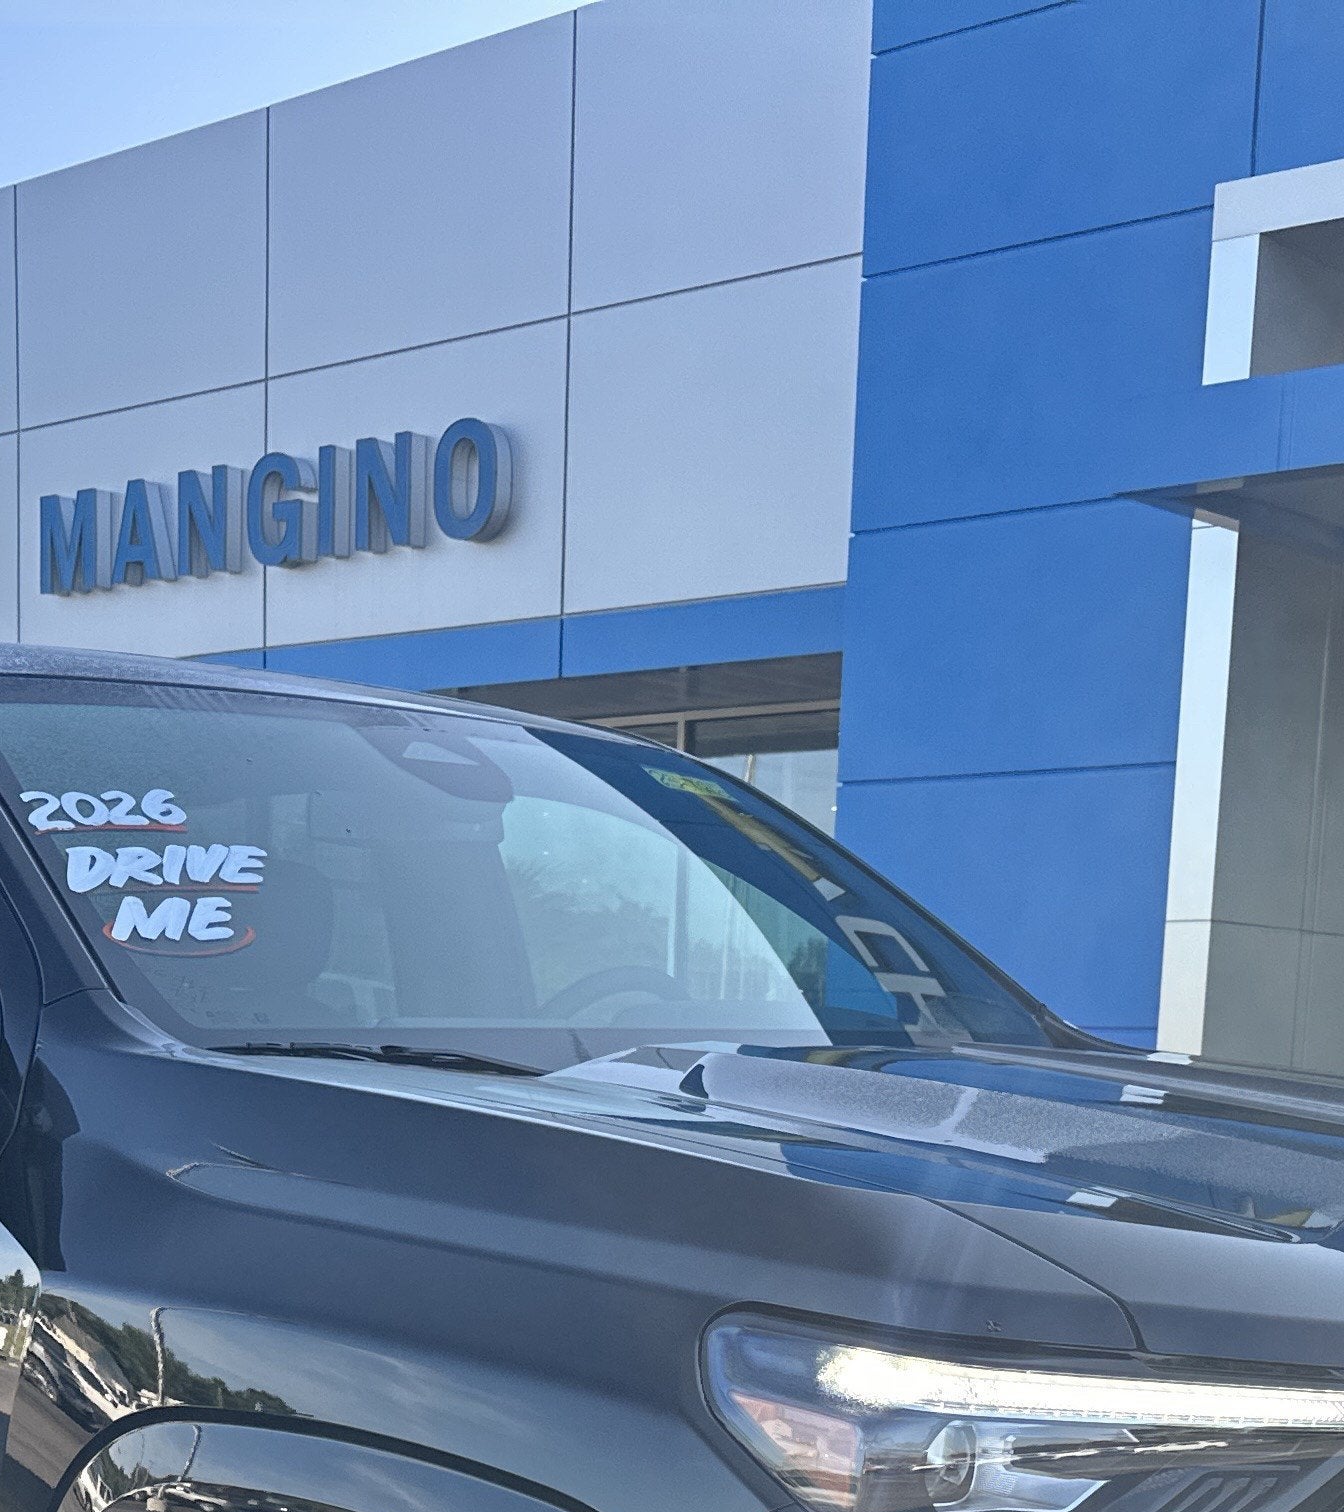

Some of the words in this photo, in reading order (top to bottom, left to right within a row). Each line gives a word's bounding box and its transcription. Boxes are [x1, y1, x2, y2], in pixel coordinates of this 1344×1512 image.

[40, 417, 510, 595] MANGINO
[19, 788, 187, 831] 2026
[65, 843, 268, 893] DRIVE
[111, 896, 235, 941] ME
